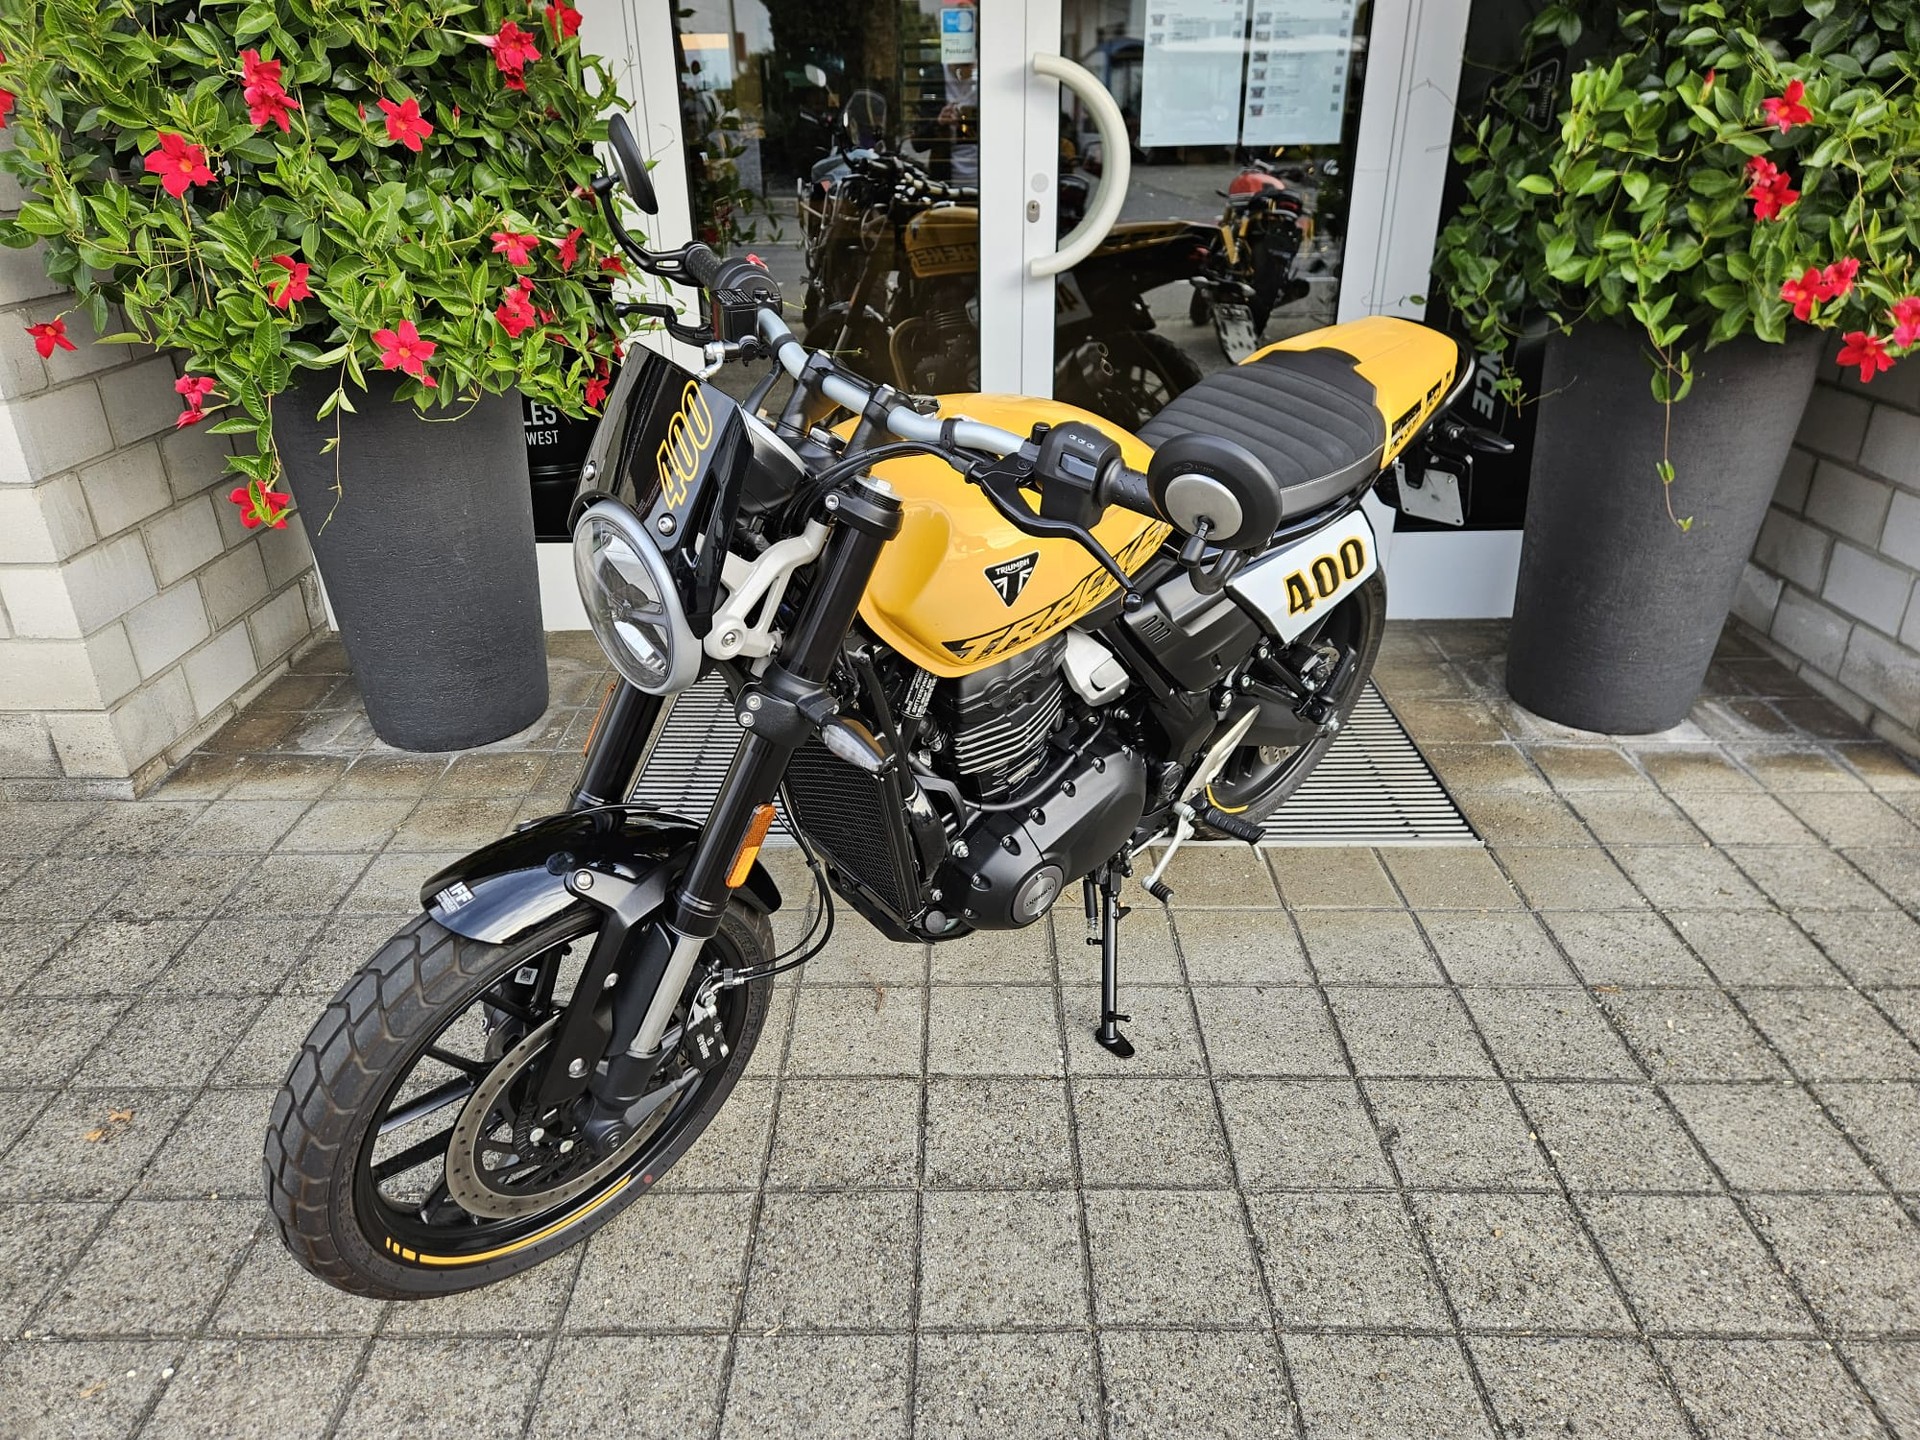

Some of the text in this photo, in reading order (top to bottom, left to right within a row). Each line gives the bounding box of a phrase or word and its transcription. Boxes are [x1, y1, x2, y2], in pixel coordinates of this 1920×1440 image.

[525, 430, 559, 446] WEST
[657, 380, 712, 510] 400
[995, 558, 1030, 576] TRIUMPH
[1284, 536, 1366, 616] 400
